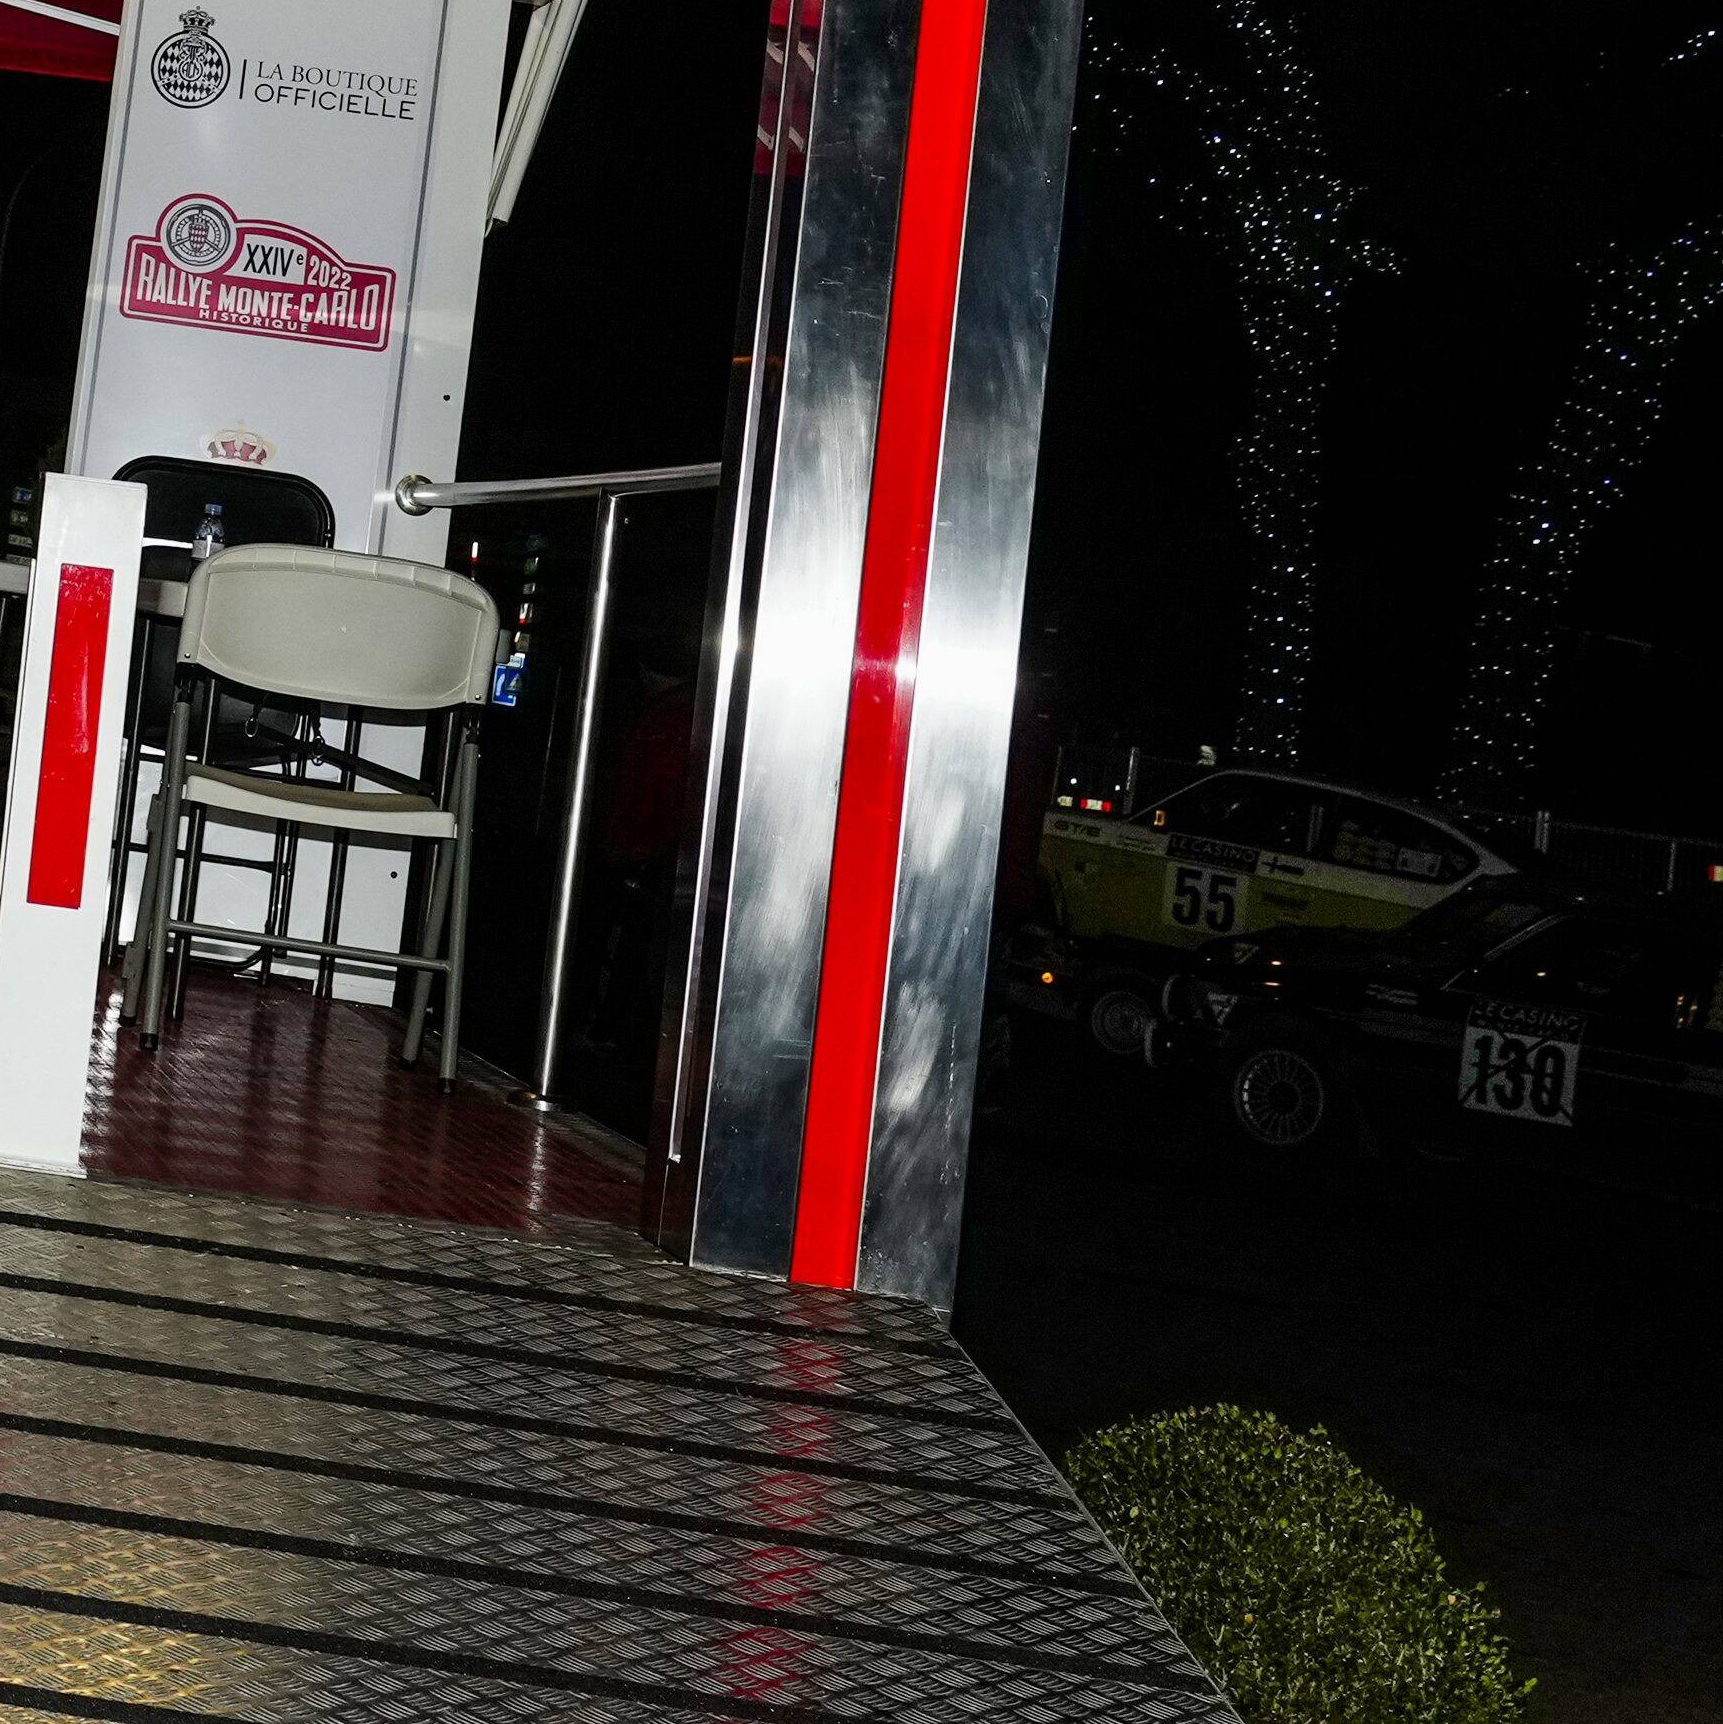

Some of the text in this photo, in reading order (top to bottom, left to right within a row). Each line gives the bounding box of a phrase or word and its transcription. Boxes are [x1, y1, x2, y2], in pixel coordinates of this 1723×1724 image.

[256, 61, 419, 98] LA BOUTIQUE
[254, 82, 416, 121] OFFICIELLE
[136, 252, 380, 331] RALLYE MONTE-CARLO
[307, 255, 352, 291] 2022
[198, 308, 310, 333] HISTORIQUE
[1189, 837, 1257, 865] CASINO
[1172, 867, 1236, 932] 55
[1475, 1035, 1567, 1118] 130
